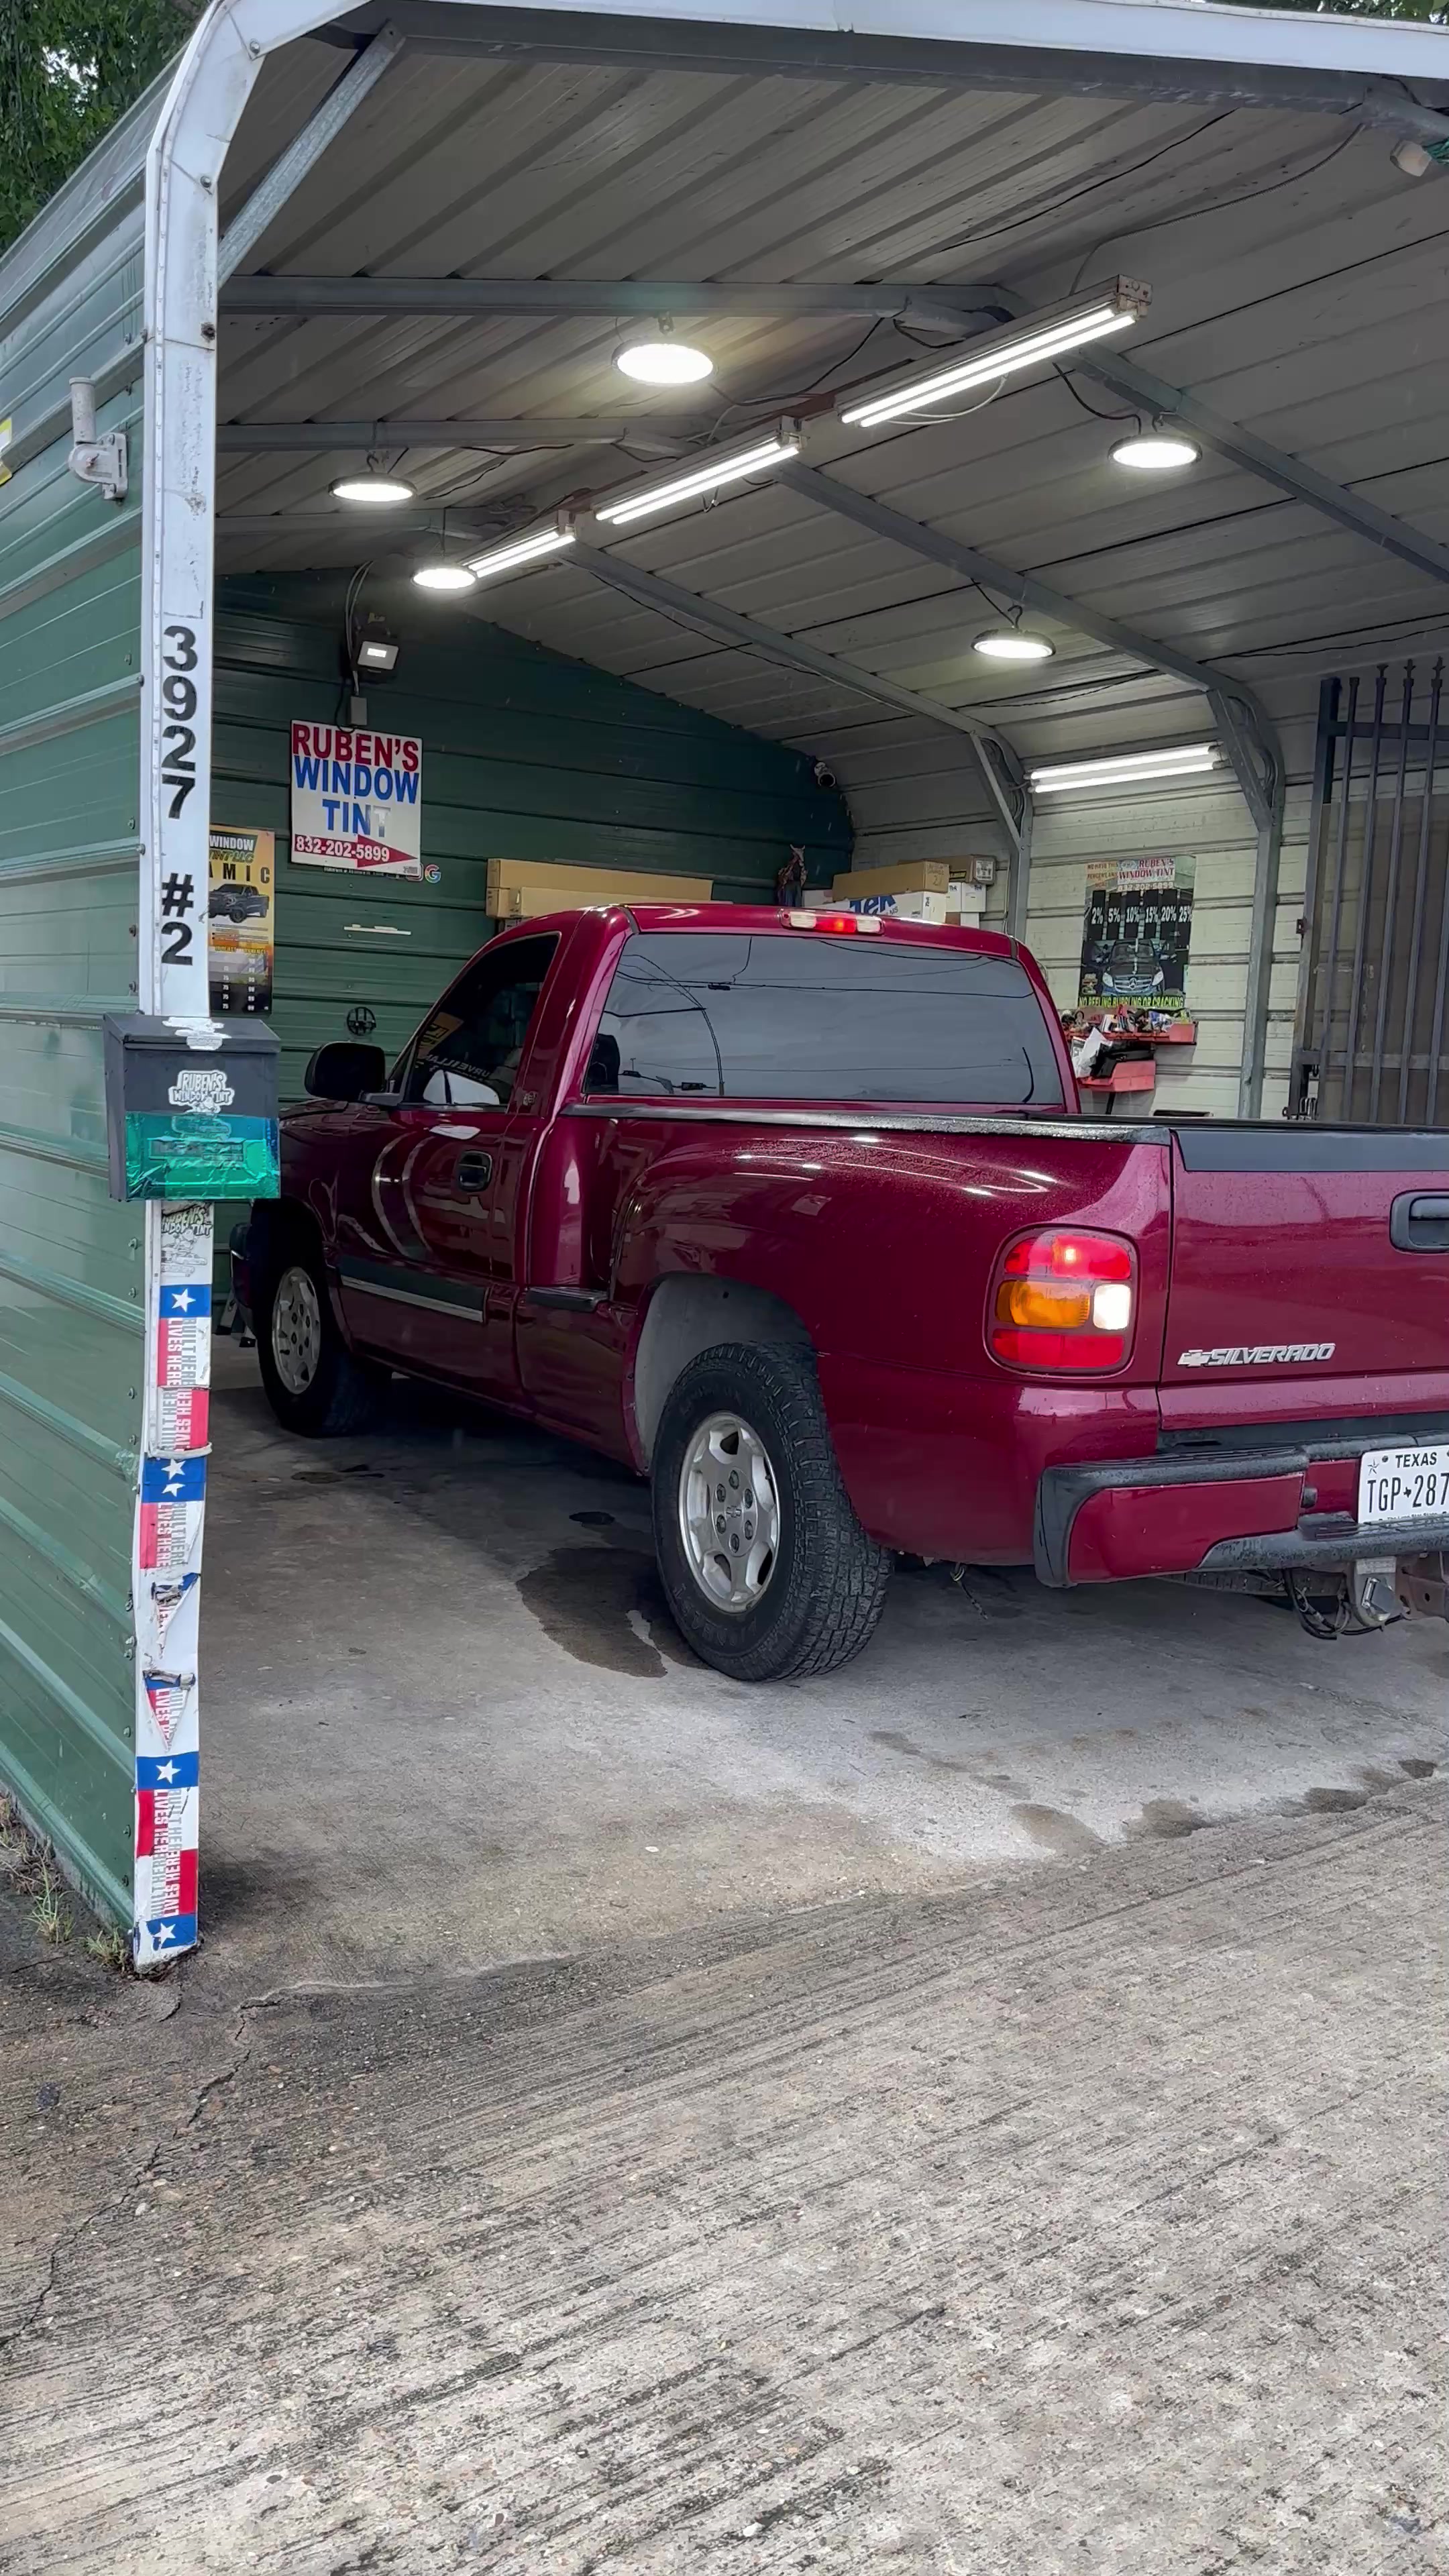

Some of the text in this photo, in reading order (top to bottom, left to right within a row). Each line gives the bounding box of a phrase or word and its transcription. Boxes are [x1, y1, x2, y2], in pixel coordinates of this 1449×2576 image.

[293, 724, 419, 771] RUBEN'S
[294, 755, 419, 804] WINDOW
[161, 625, 198, 965] 3927 #2
[322, 799, 391, 838] TINT
[209, 835, 254, 851] WINDOW
[297, 836, 390, 862] 832-202-5899
[1118, 869, 1152, 879] WINDOW
[1156, 868, 1174, 877] TINT
[1091, 906, 1192, 924] 2% 5% 10% 15% 20% 25%
[1079, 996, 1087, 1006] NO
[1144, 997, 1152, 1007] OR
[1152, 996, 1183, 1008] CRACKING
[210, 1091, 230, 1103] TINT
[191, 1224, 211, 1236] TINT
[1208, 1344, 1336, 1366] SILVERADO
[1395, 1452, 1437, 1468] TEXAS
[154, 1789, 169, 1825] LIVES
[164, 1882, 180, 1916] LIVES
